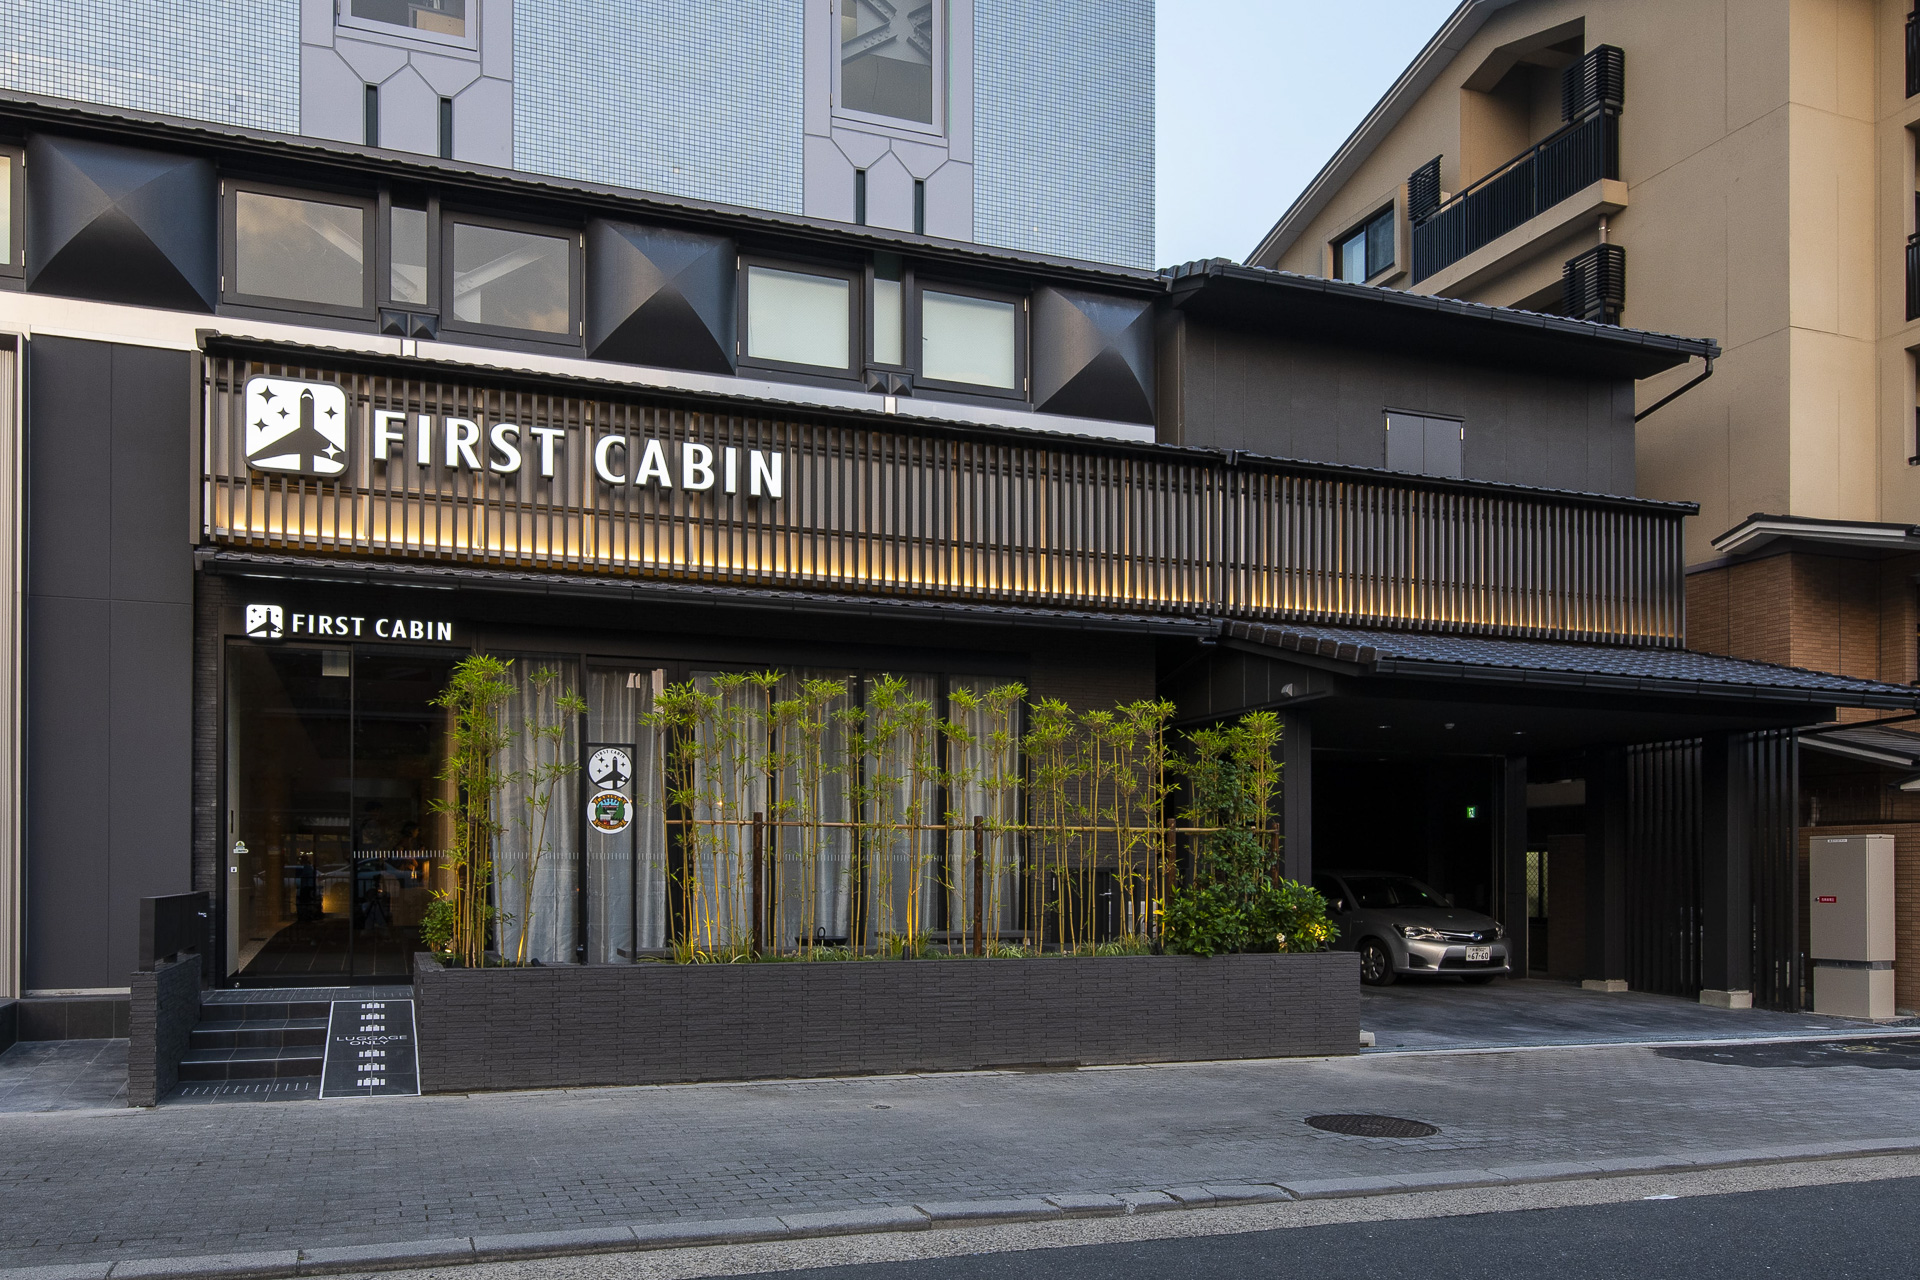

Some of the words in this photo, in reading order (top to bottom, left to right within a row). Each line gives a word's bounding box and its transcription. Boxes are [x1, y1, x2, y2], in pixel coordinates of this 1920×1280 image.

[374, 409, 566, 478] FIRST
[594, 435, 783, 499] CABIN
[292, 613, 365, 636] FIRST
[375, 618, 452, 641] CABIN
